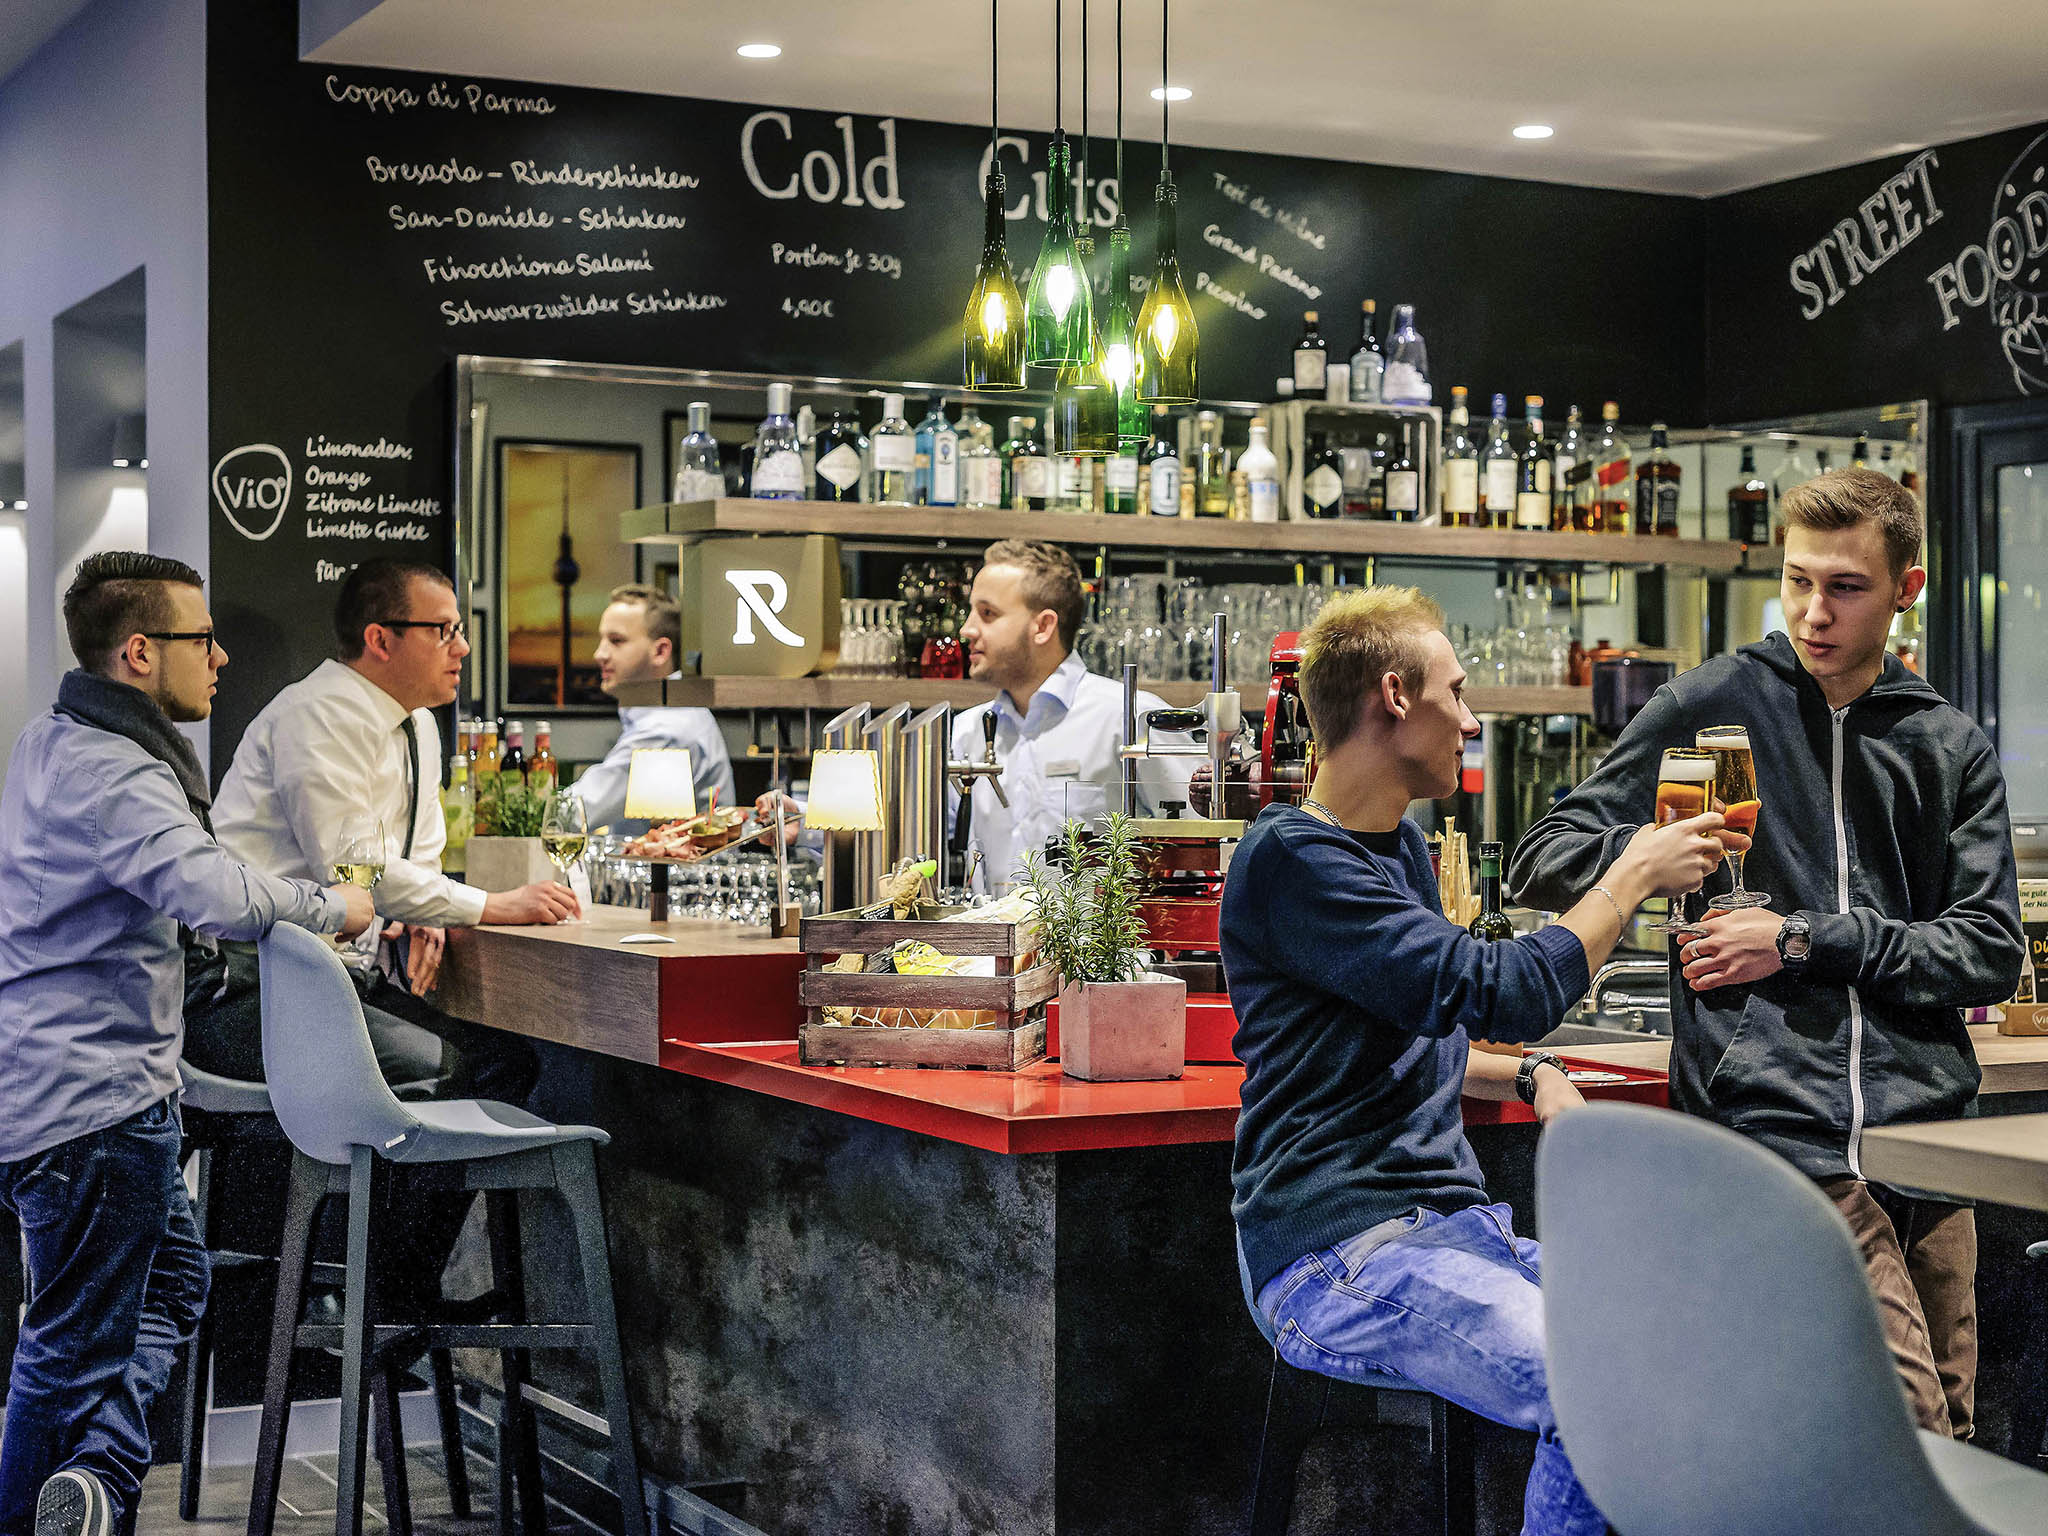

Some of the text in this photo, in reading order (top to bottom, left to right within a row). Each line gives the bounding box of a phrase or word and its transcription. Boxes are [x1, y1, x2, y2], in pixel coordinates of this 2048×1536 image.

[325, 74, 557, 114] Coppa di Parma
[366, 156, 483, 185] Bresaola
[510, 159, 700, 190] Rinderschinken
[741, 111, 904, 209] Cold
[388, 205, 554, 231] San-Daniele
[578, 205, 687, 231] Schinken
[1790, 150, 1944, 321] STREET
[423, 249, 654, 284] Finocchiona Salami
[771, 242, 902, 281] Portion je 30g
[1927, 190, 2048, 331] FOOD
[440, 287, 728, 326] Schwarzwälder Schinken
[305, 465, 371, 492] Orange
[305, 492, 442, 517] Zitrone Limette
[306, 517, 429, 542] Limette Gurke
